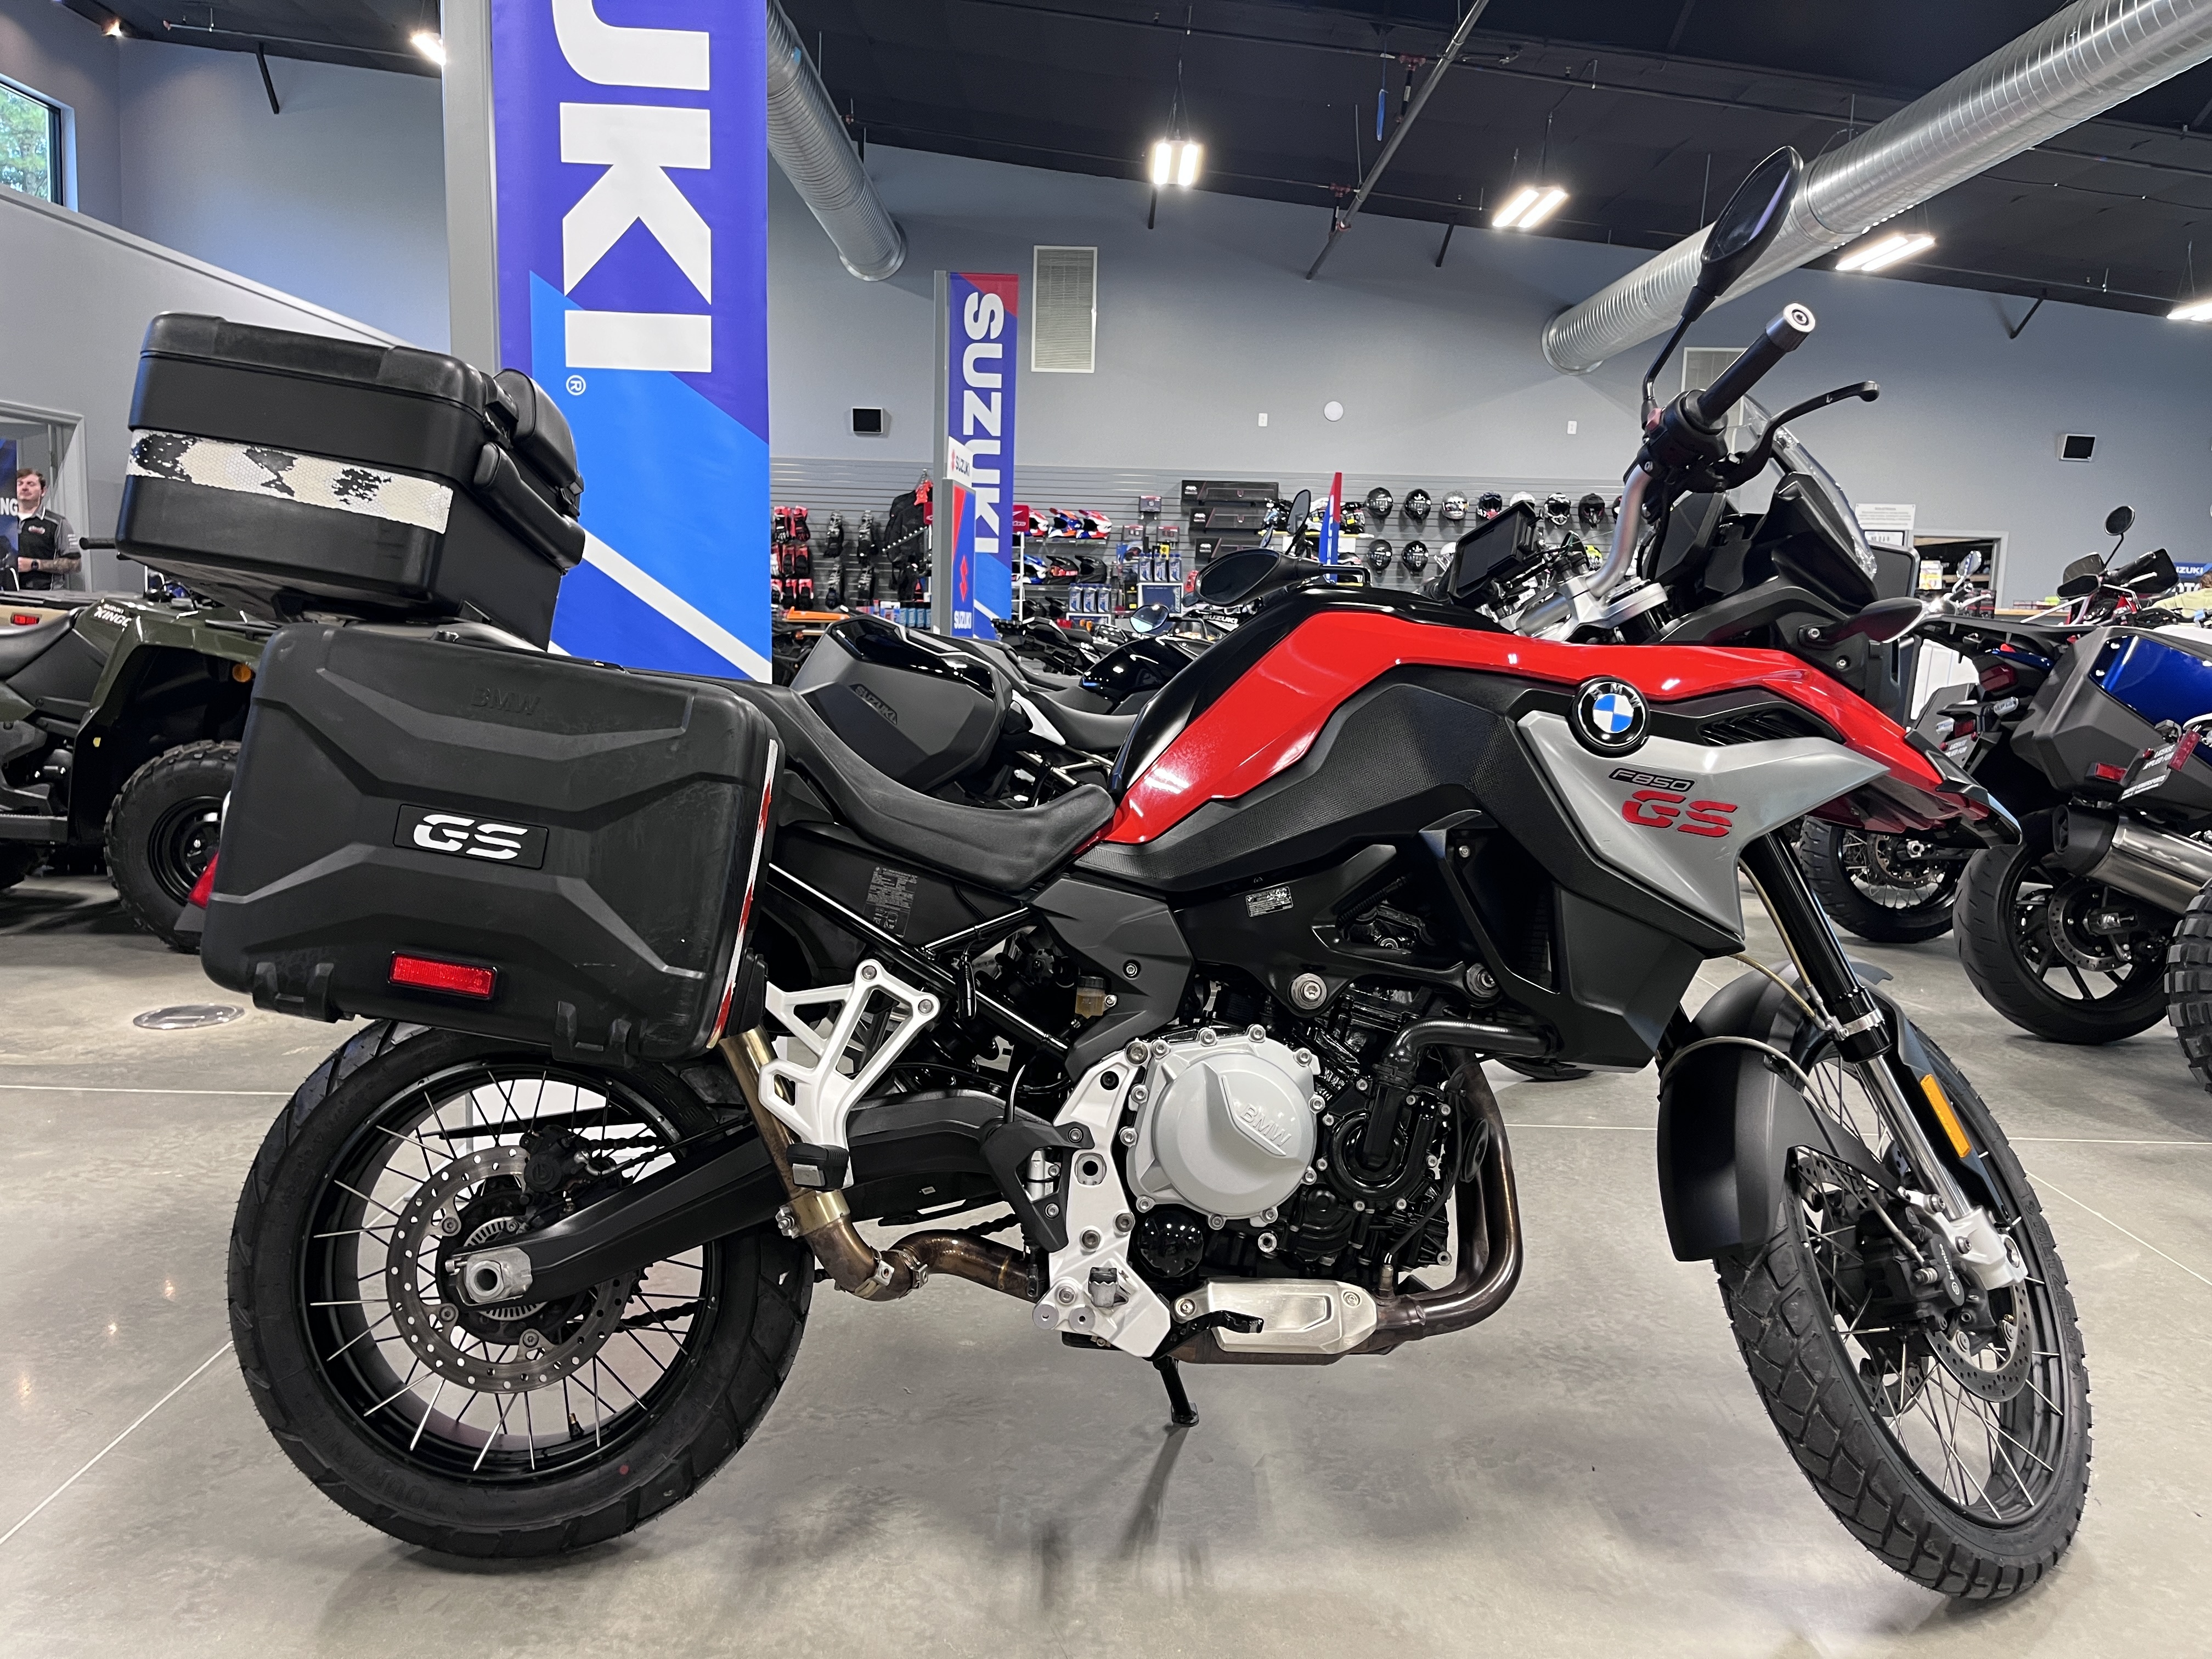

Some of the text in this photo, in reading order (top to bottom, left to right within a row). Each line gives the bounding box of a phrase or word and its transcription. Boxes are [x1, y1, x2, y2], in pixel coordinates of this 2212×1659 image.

[963, 292, 1004, 553] SUZUKI
[1203, 614, 1238, 624] SUZUKI
[855, 686, 896, 721] SUZUKI
[1612, 769, 1691, 791] F850
[1621, 789, 1738, 838] GS
[413, 814, 528, 860] GS
[1240, 1103, 1292, 1147] BMW
